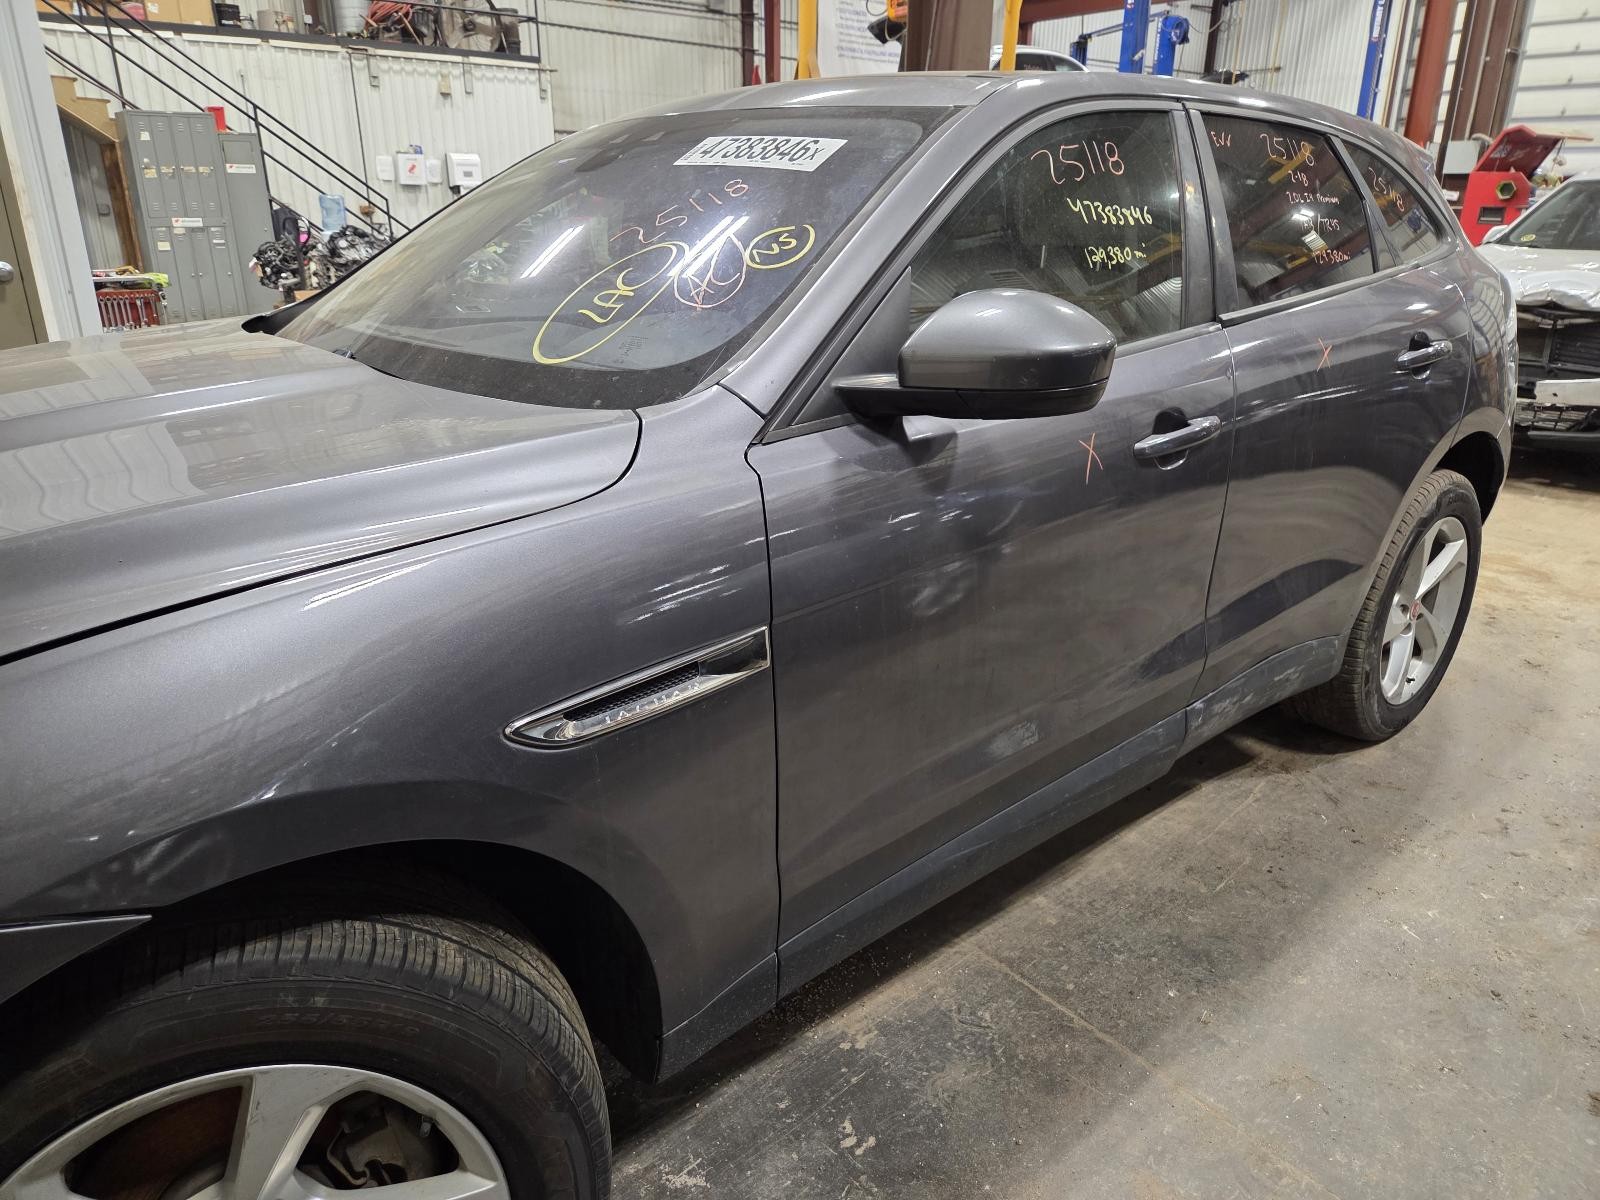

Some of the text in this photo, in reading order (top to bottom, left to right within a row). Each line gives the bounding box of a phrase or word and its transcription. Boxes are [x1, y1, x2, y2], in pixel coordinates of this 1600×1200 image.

[1030, 140, 1125, 185] 25118
[1259, 133, 1315, 167] 25118
[1066, 197, 1153, 226] 47383846
[1368, 166, 1405, 212] 25118
[609, 179, 750, 245] 25118
